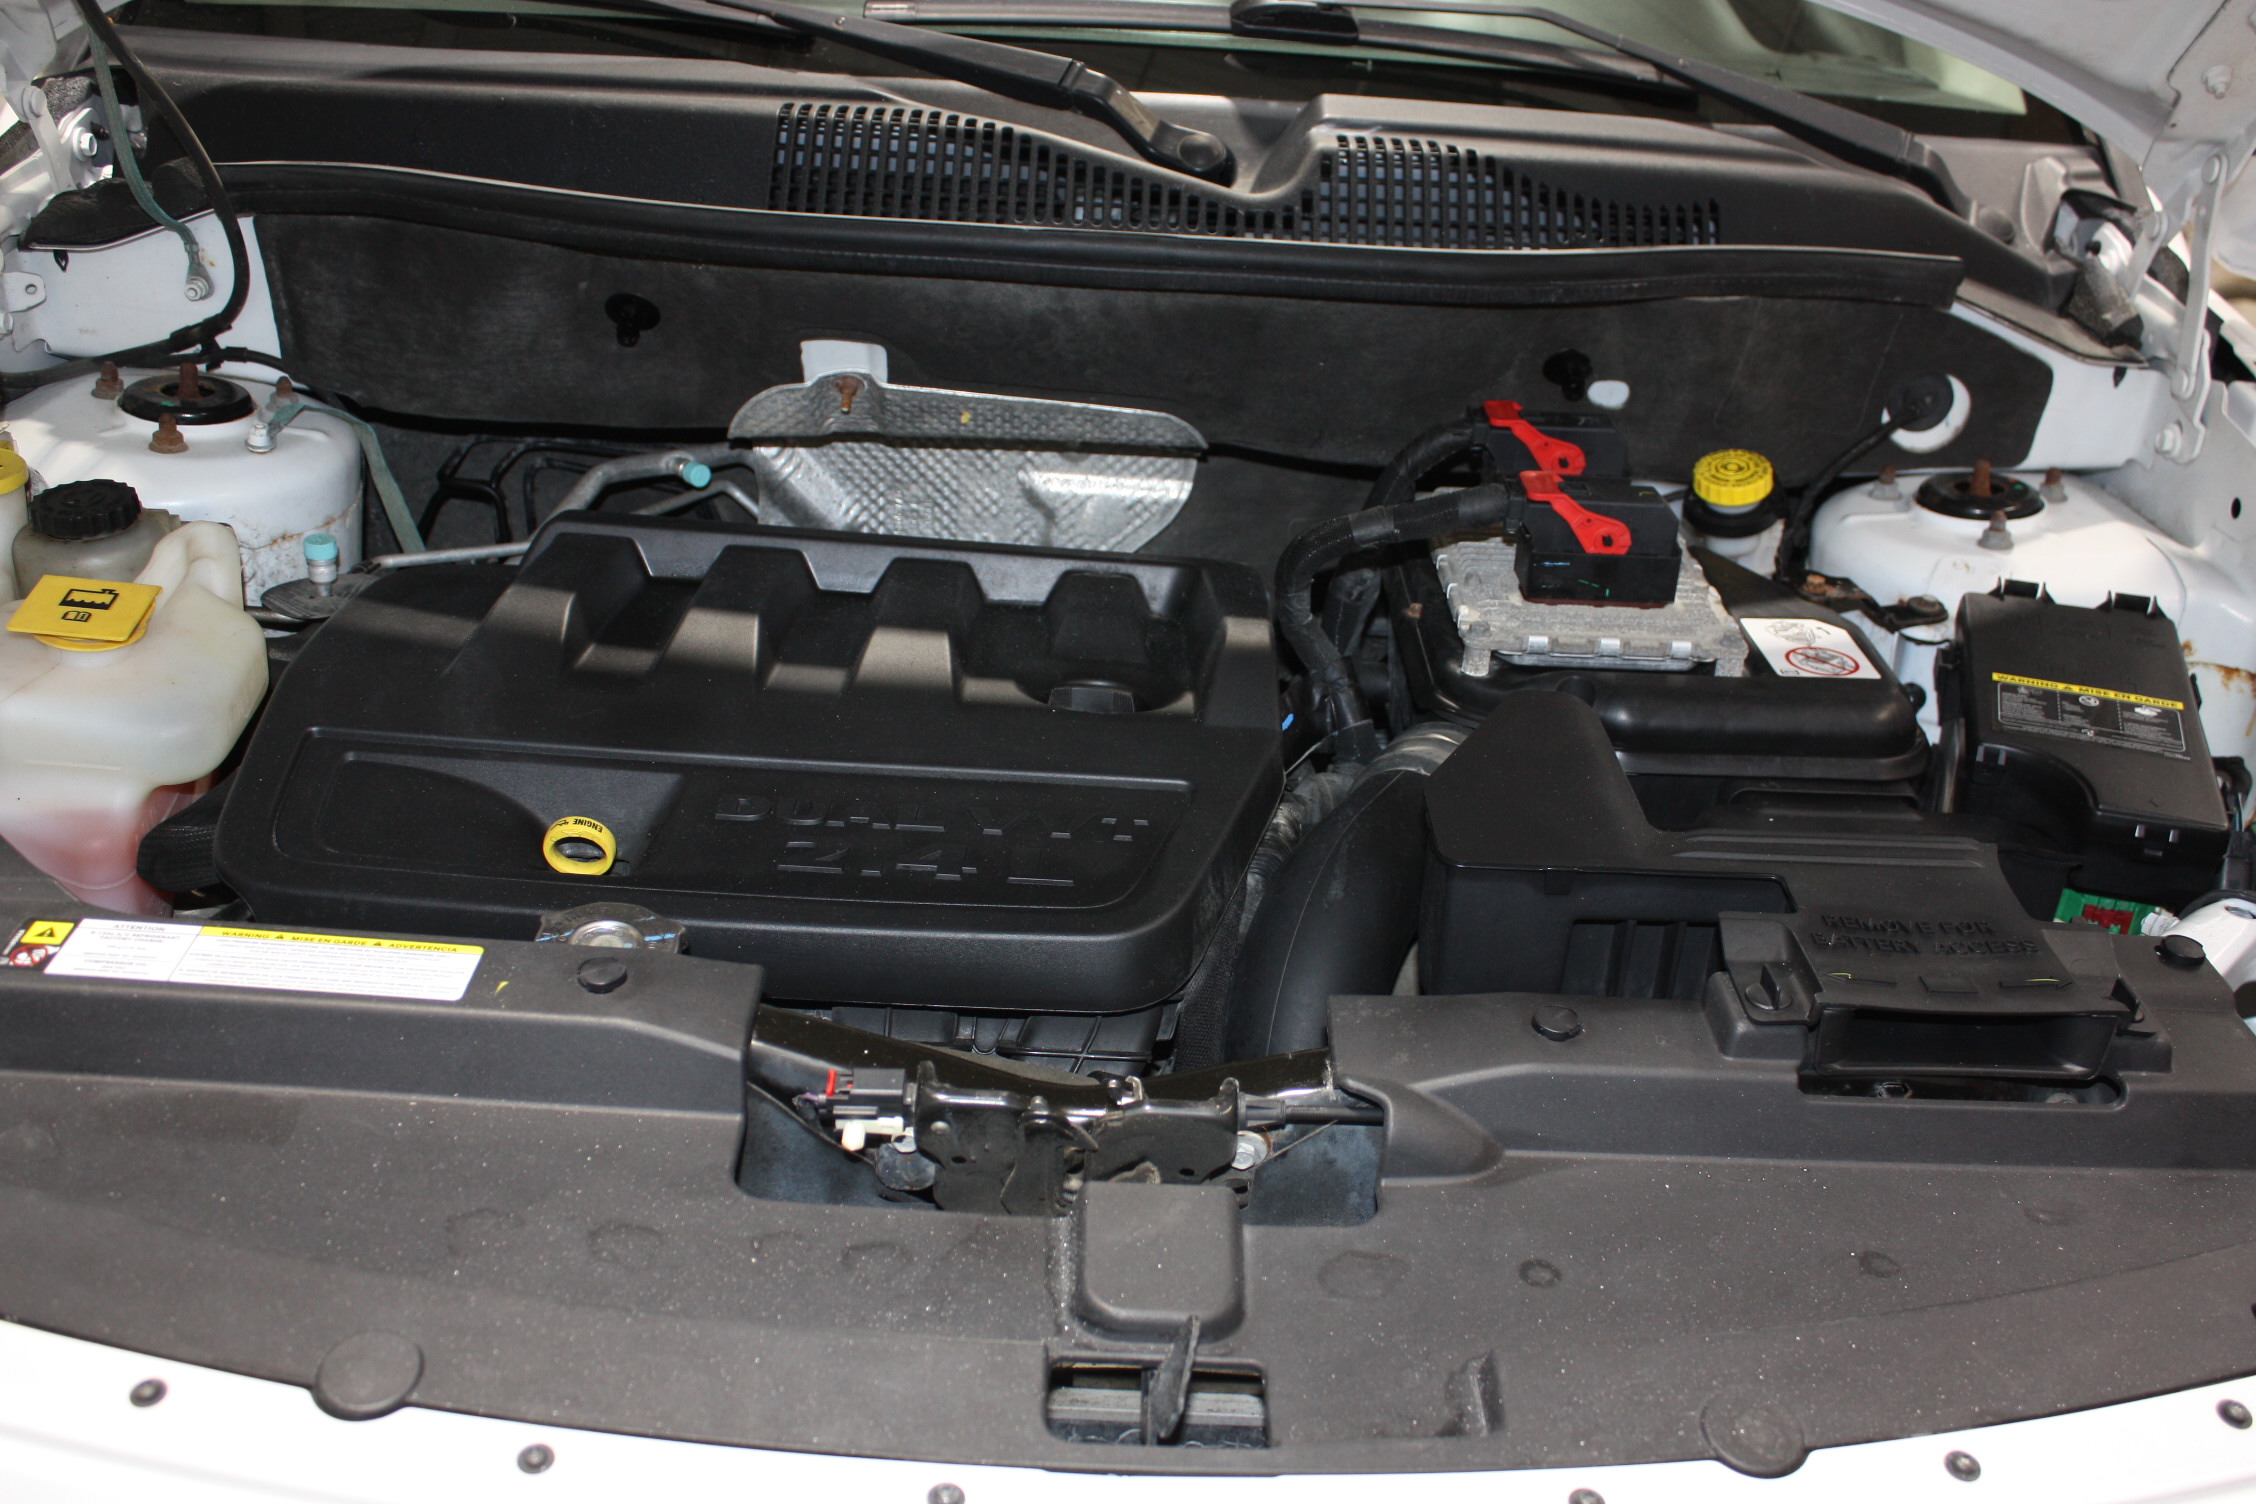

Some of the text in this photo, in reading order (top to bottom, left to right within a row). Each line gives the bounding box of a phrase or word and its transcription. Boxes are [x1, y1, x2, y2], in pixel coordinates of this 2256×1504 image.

[714, 792, 946, 833] DUAL
[572, 818, 604, 834] ENGINE
[113, 923, 166, 932] ATTENTION
[1820, 914, 1996, 936] REMOVE FOR
[221, 930, 271, 940] WARNING
[388, 942, 458, 953] ADVERTENCIA
[1811, 932, 2040, 956] BATTERY ACCESS
